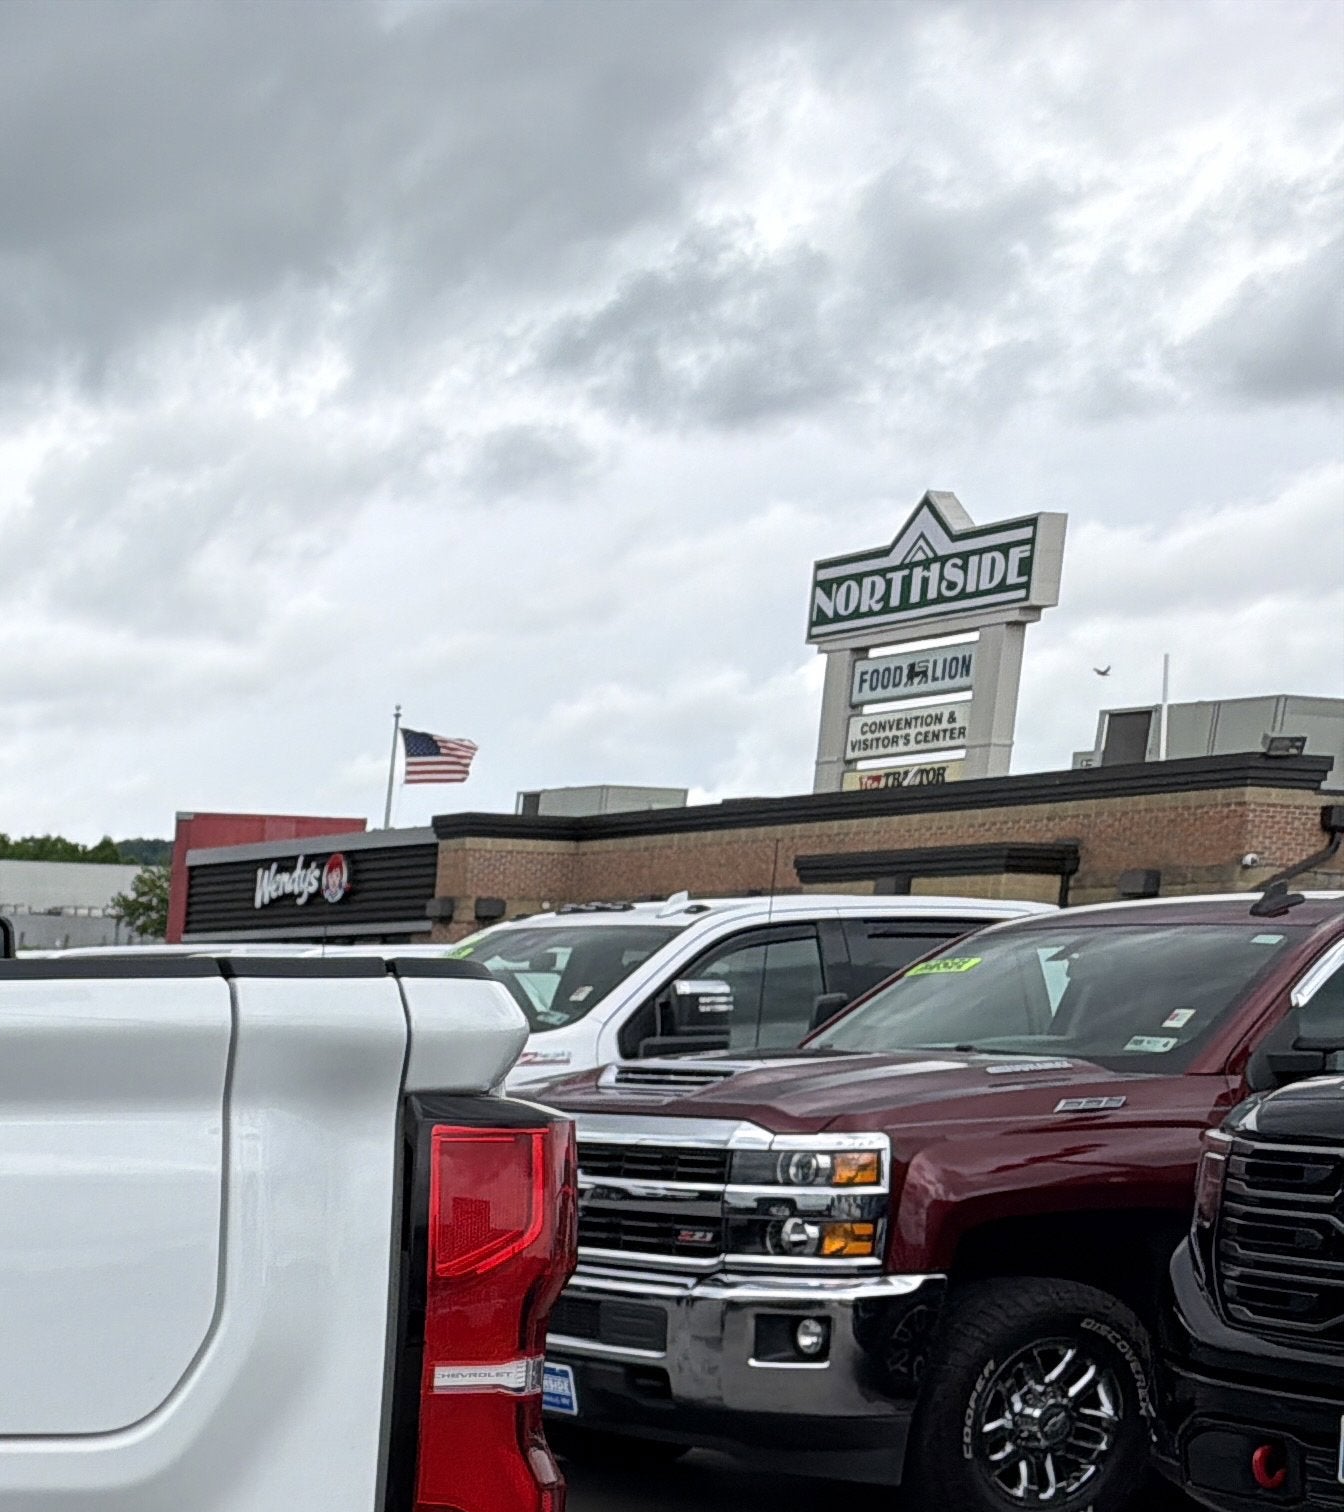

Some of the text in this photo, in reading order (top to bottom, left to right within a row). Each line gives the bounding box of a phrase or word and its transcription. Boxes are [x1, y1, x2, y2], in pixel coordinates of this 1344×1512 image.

[812, 544, 1032, 622] NORTHSIDE
[858, 654, 973, 693] FOOD LION
[850, 726, 967, 753] VISITOR'S CENTER
[860, 710, 957, 736] CONVENTION &
[884, 766, 946, 788] TRTOR
[254, 855, 320, 909] Wendy's
[437, 1371, 514, 1379] CHEVROLET
[962, 1358, 995, 1460] COOPER
